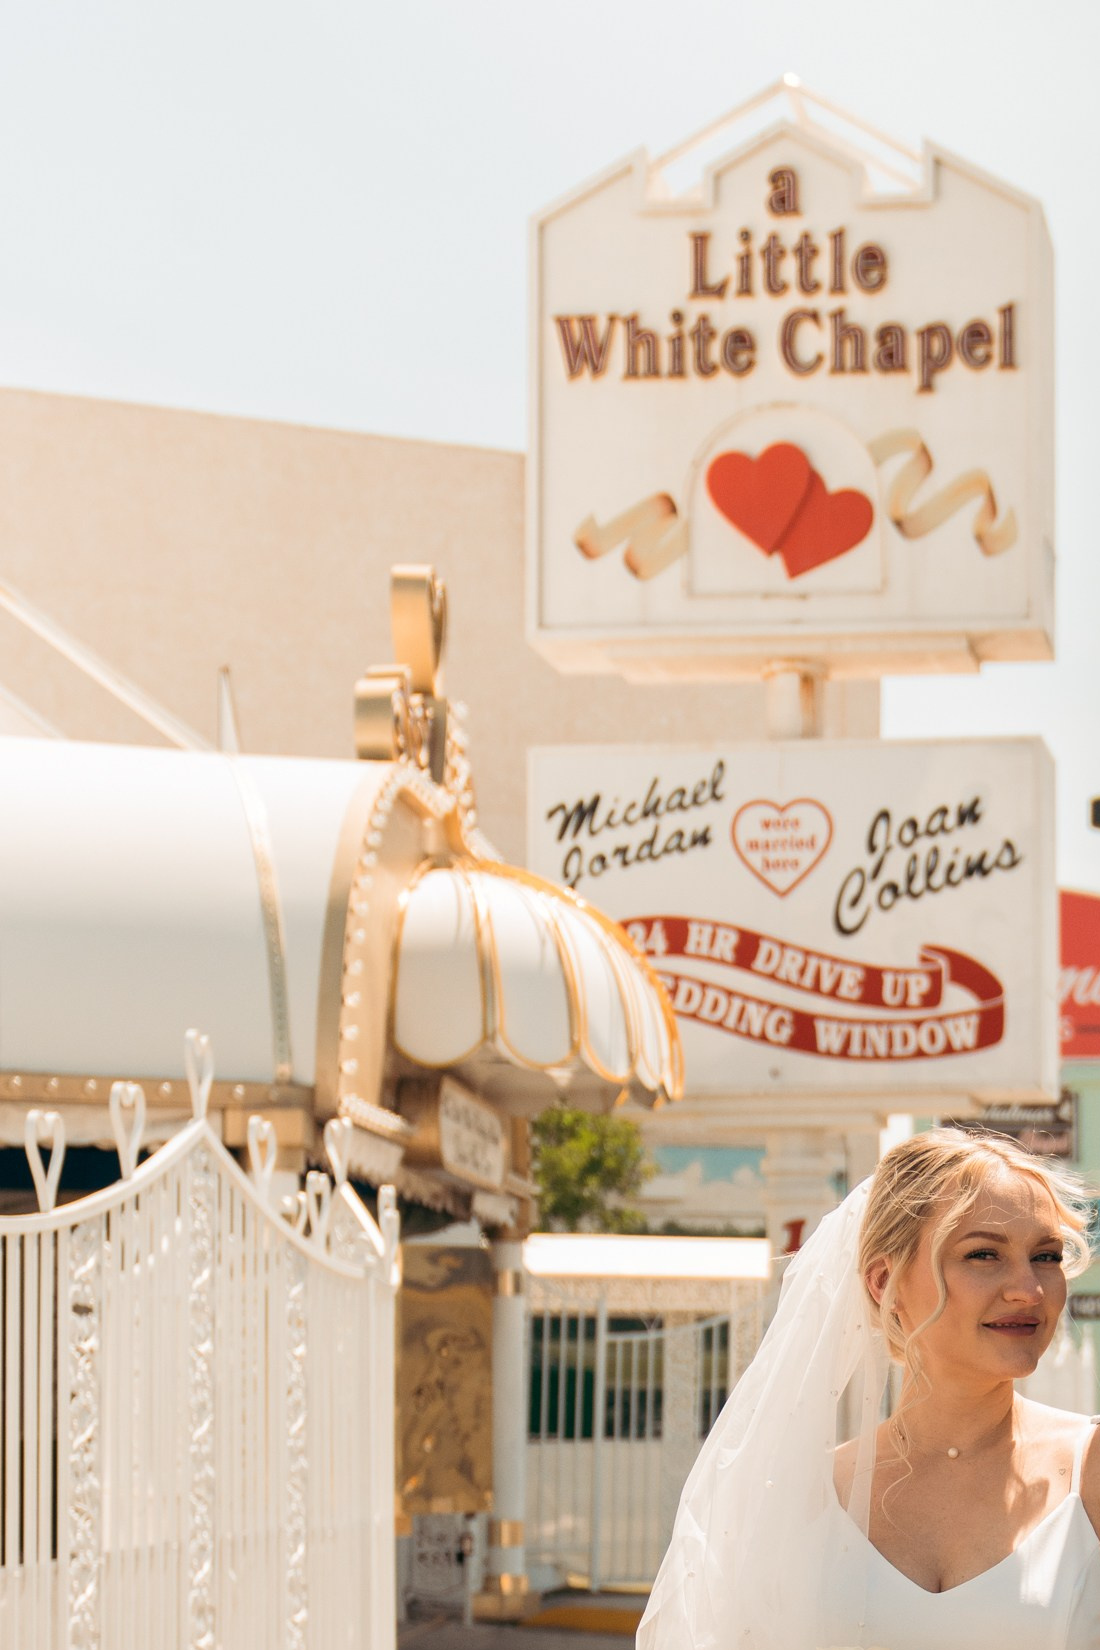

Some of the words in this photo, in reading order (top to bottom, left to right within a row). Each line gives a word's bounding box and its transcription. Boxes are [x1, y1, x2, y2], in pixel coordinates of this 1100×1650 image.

[767, 165, 801, 217] a
[688, 228, 888, 300] Little
[554, 311, 757, 382] White
[780, 304, 1019, 394] Chapel
[546, 759, 726, 842] Michael
[761, 818, 799, 831] were
[562, 822, 712, 889] Jordan
[746, 834, 816, 851] married
[761, 856, 799, 871] here
[866, 796, 984, 881] Joan
[833, 838, 1023, 937] Collins
[626, 919, 668, 957] 24
[684, 920, 739, 963] HR
[751, 936, 866, 1001] DRIVE
[881, 971, 931, 1008] UP
[813, 1011, 980, 1058] WINDOW
